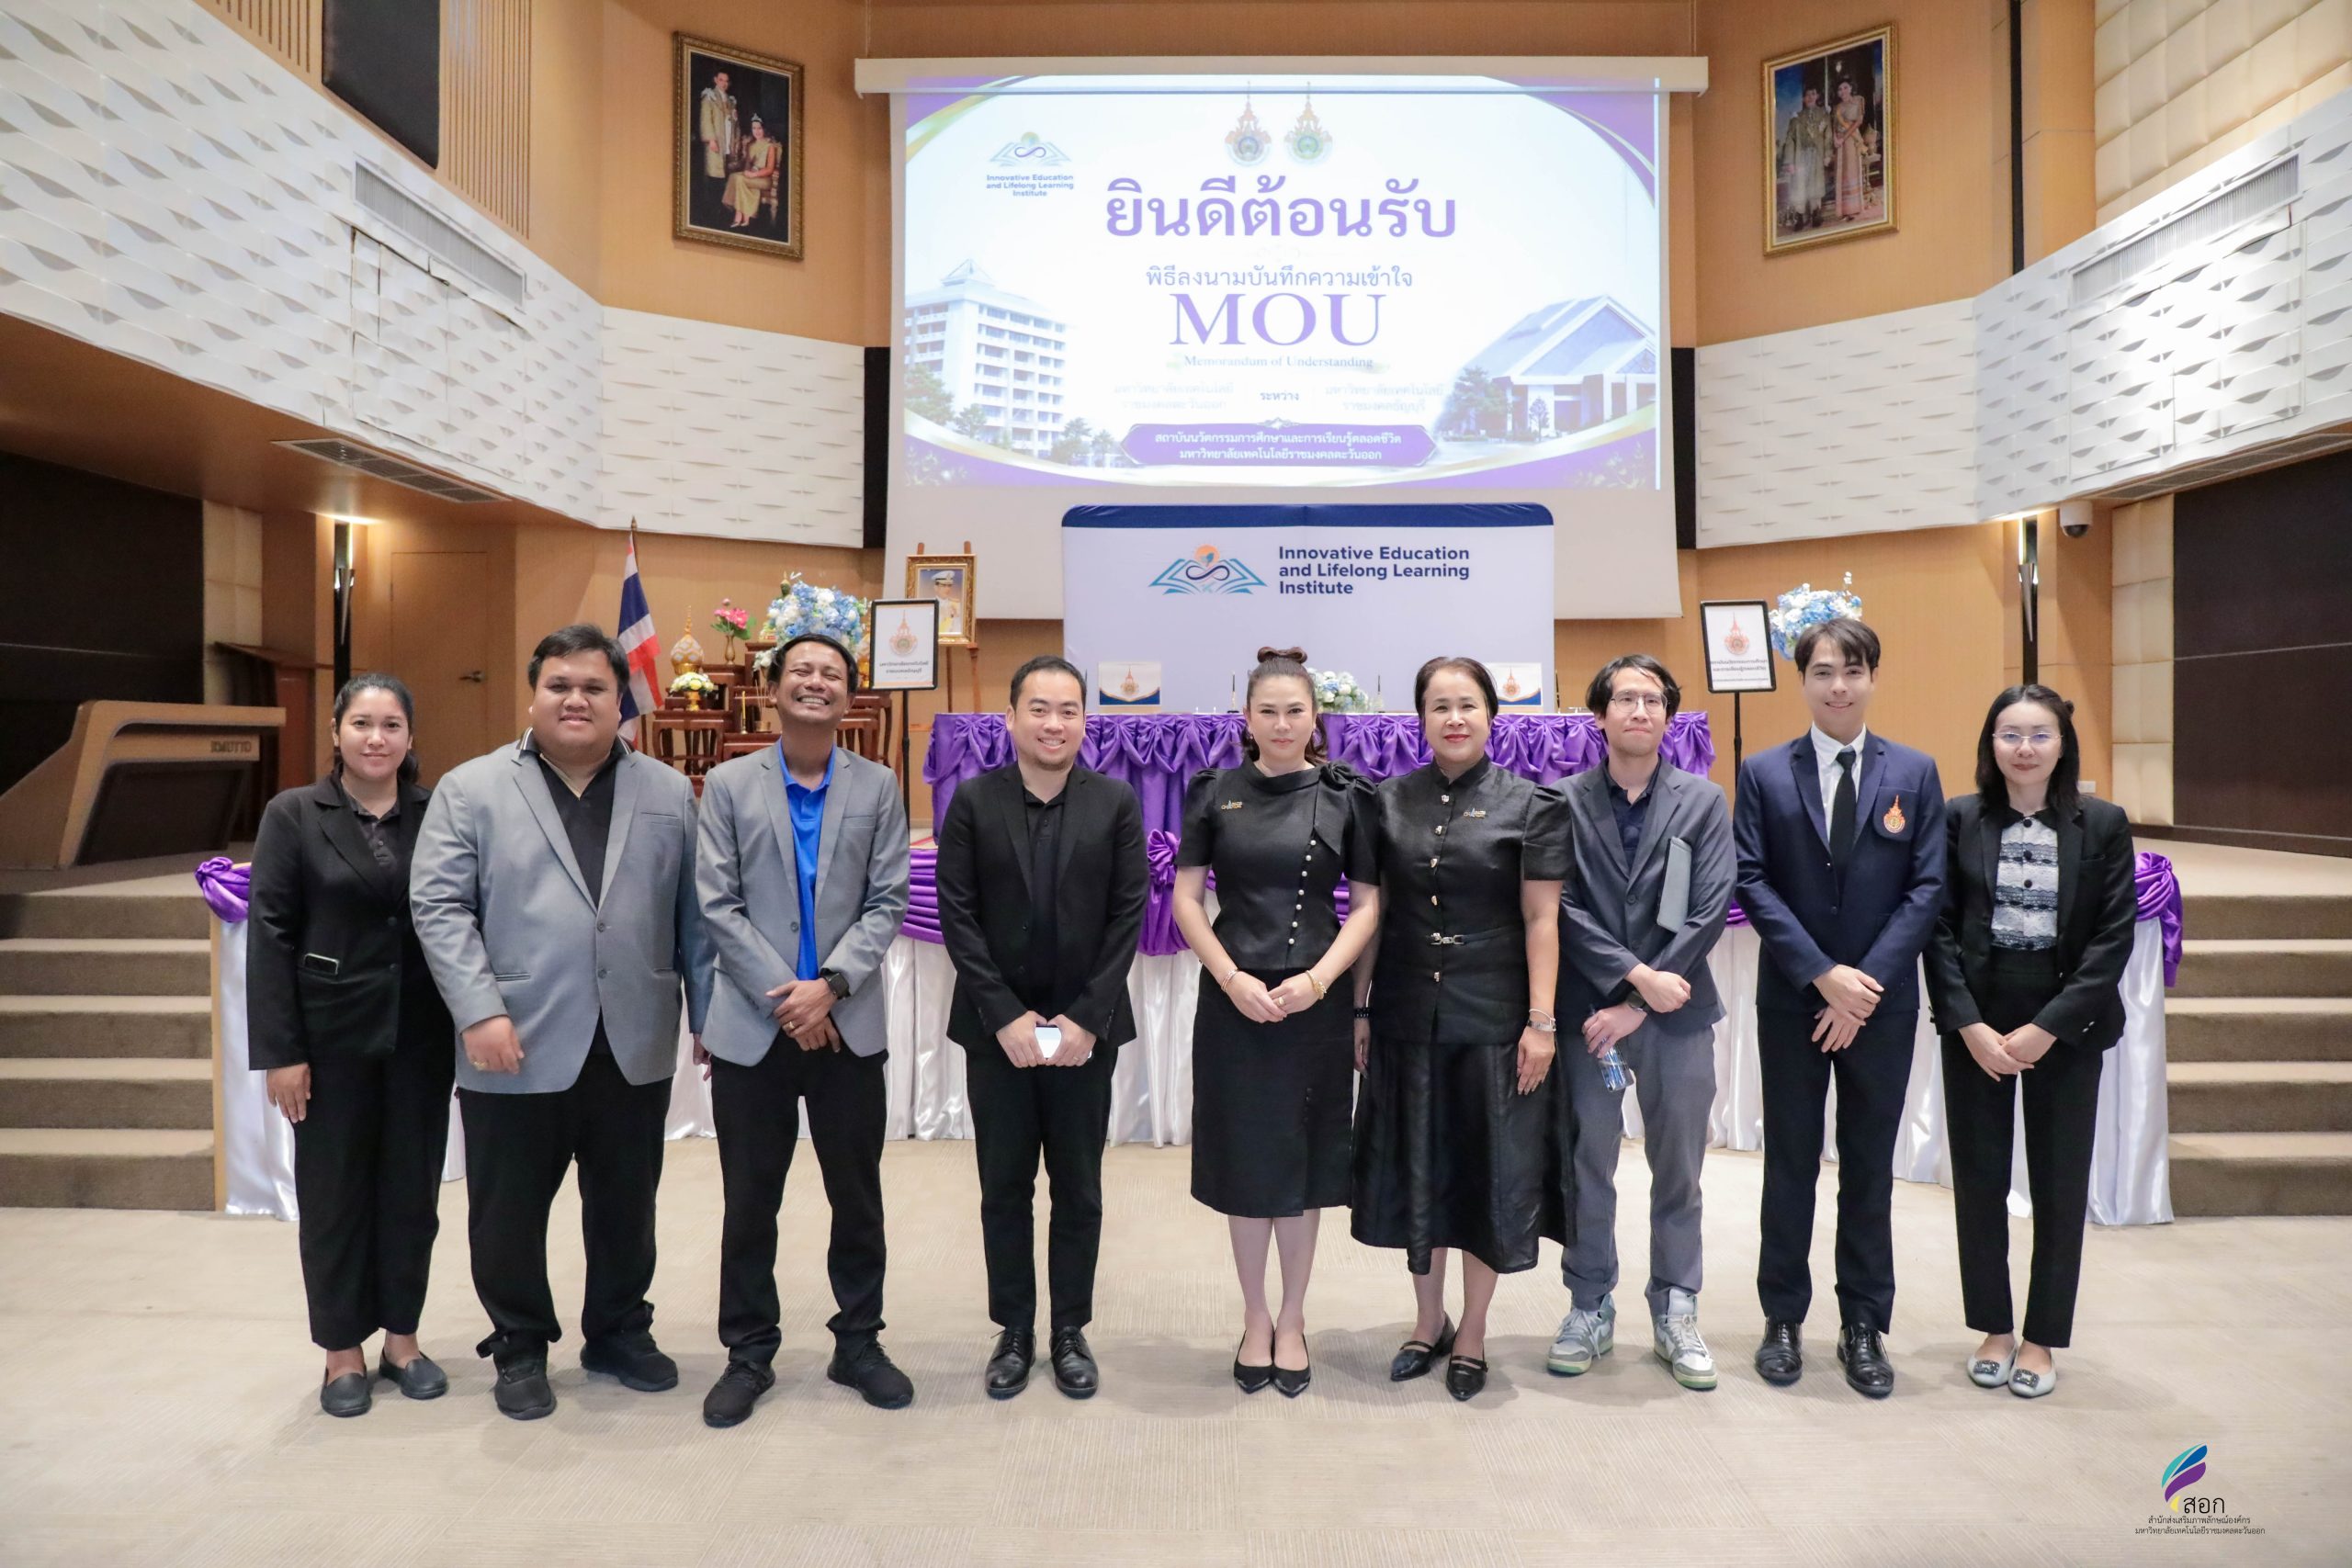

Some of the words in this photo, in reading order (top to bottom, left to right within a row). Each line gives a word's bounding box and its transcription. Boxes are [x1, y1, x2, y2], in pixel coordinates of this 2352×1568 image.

[1107, 175, 1455, 237] ยินดีต้อนรับ
[1147, 265, 1412, 287] พิธีลงนามบันทึกความเข้าใจ
[1170, 293, 1386, 346] MOU
[1183, 355, 1267, 367] Memorandum
[1270, 355, 1283, 367] of
[1260, 389, 1300, 401] ระหว่าง
[1280, 546, 1374, 559] Innovative
[1380, 546, 1469, 559] Education
[1280, 564, 1311, 577] and
[1317, 563, 1387, 580] Lifelong
[1394, 563, 1469, 580] Learning
[1280, 581, 1353, 594] Institute
